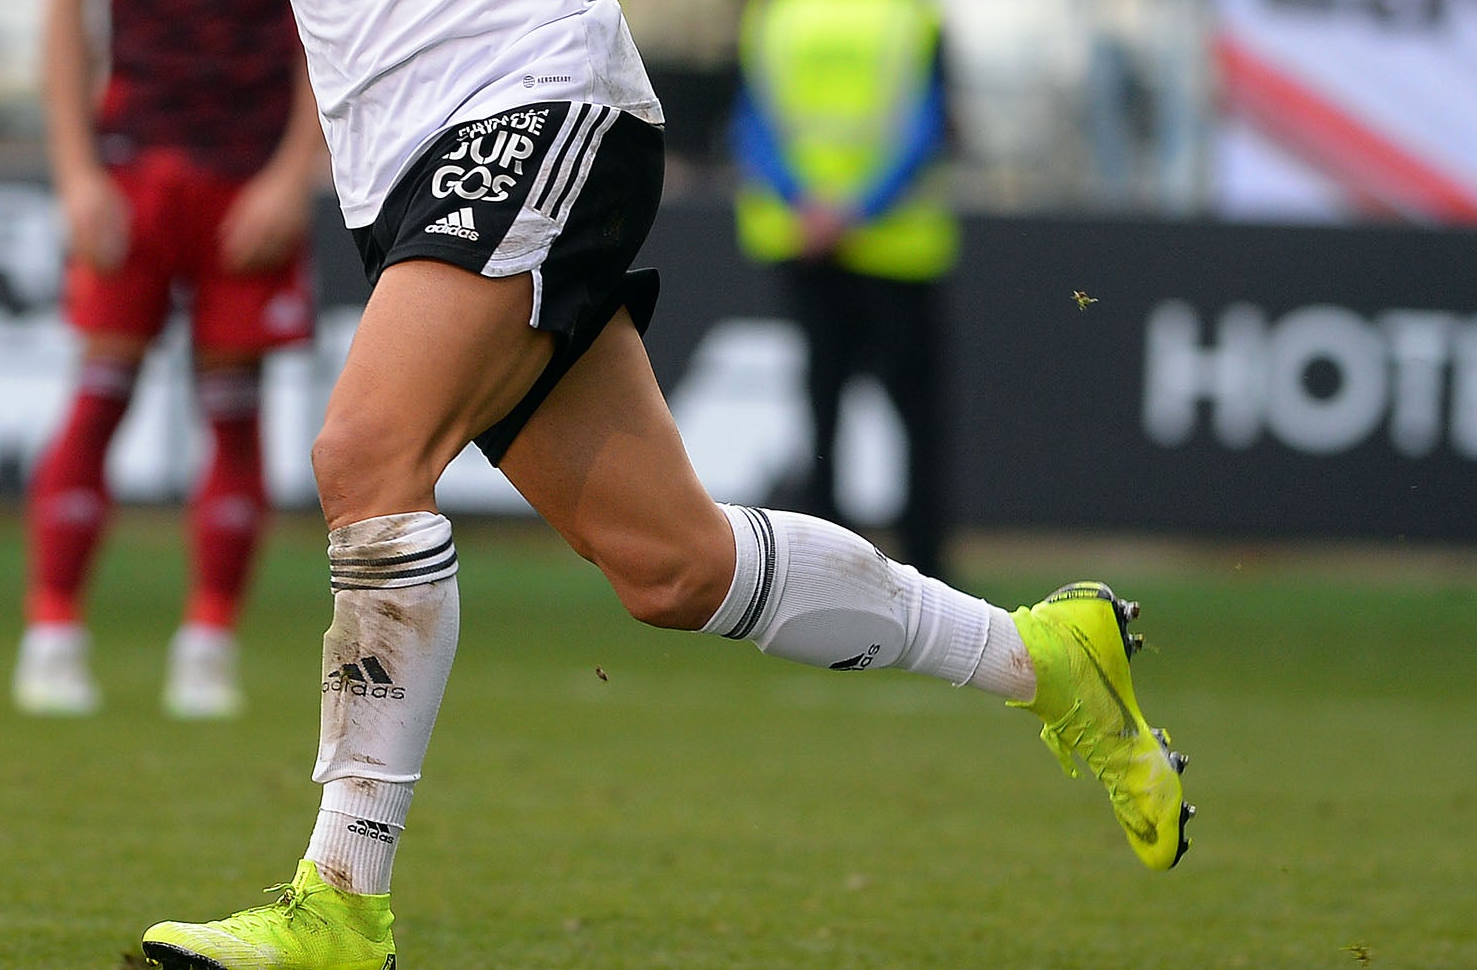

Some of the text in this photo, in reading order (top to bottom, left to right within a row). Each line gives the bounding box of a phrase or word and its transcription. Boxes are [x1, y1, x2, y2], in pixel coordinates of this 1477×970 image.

[431, 164, 517, 202] GOS
[425, 223, 480, 242] adidas
[347, 822, 394, 844] adidas
